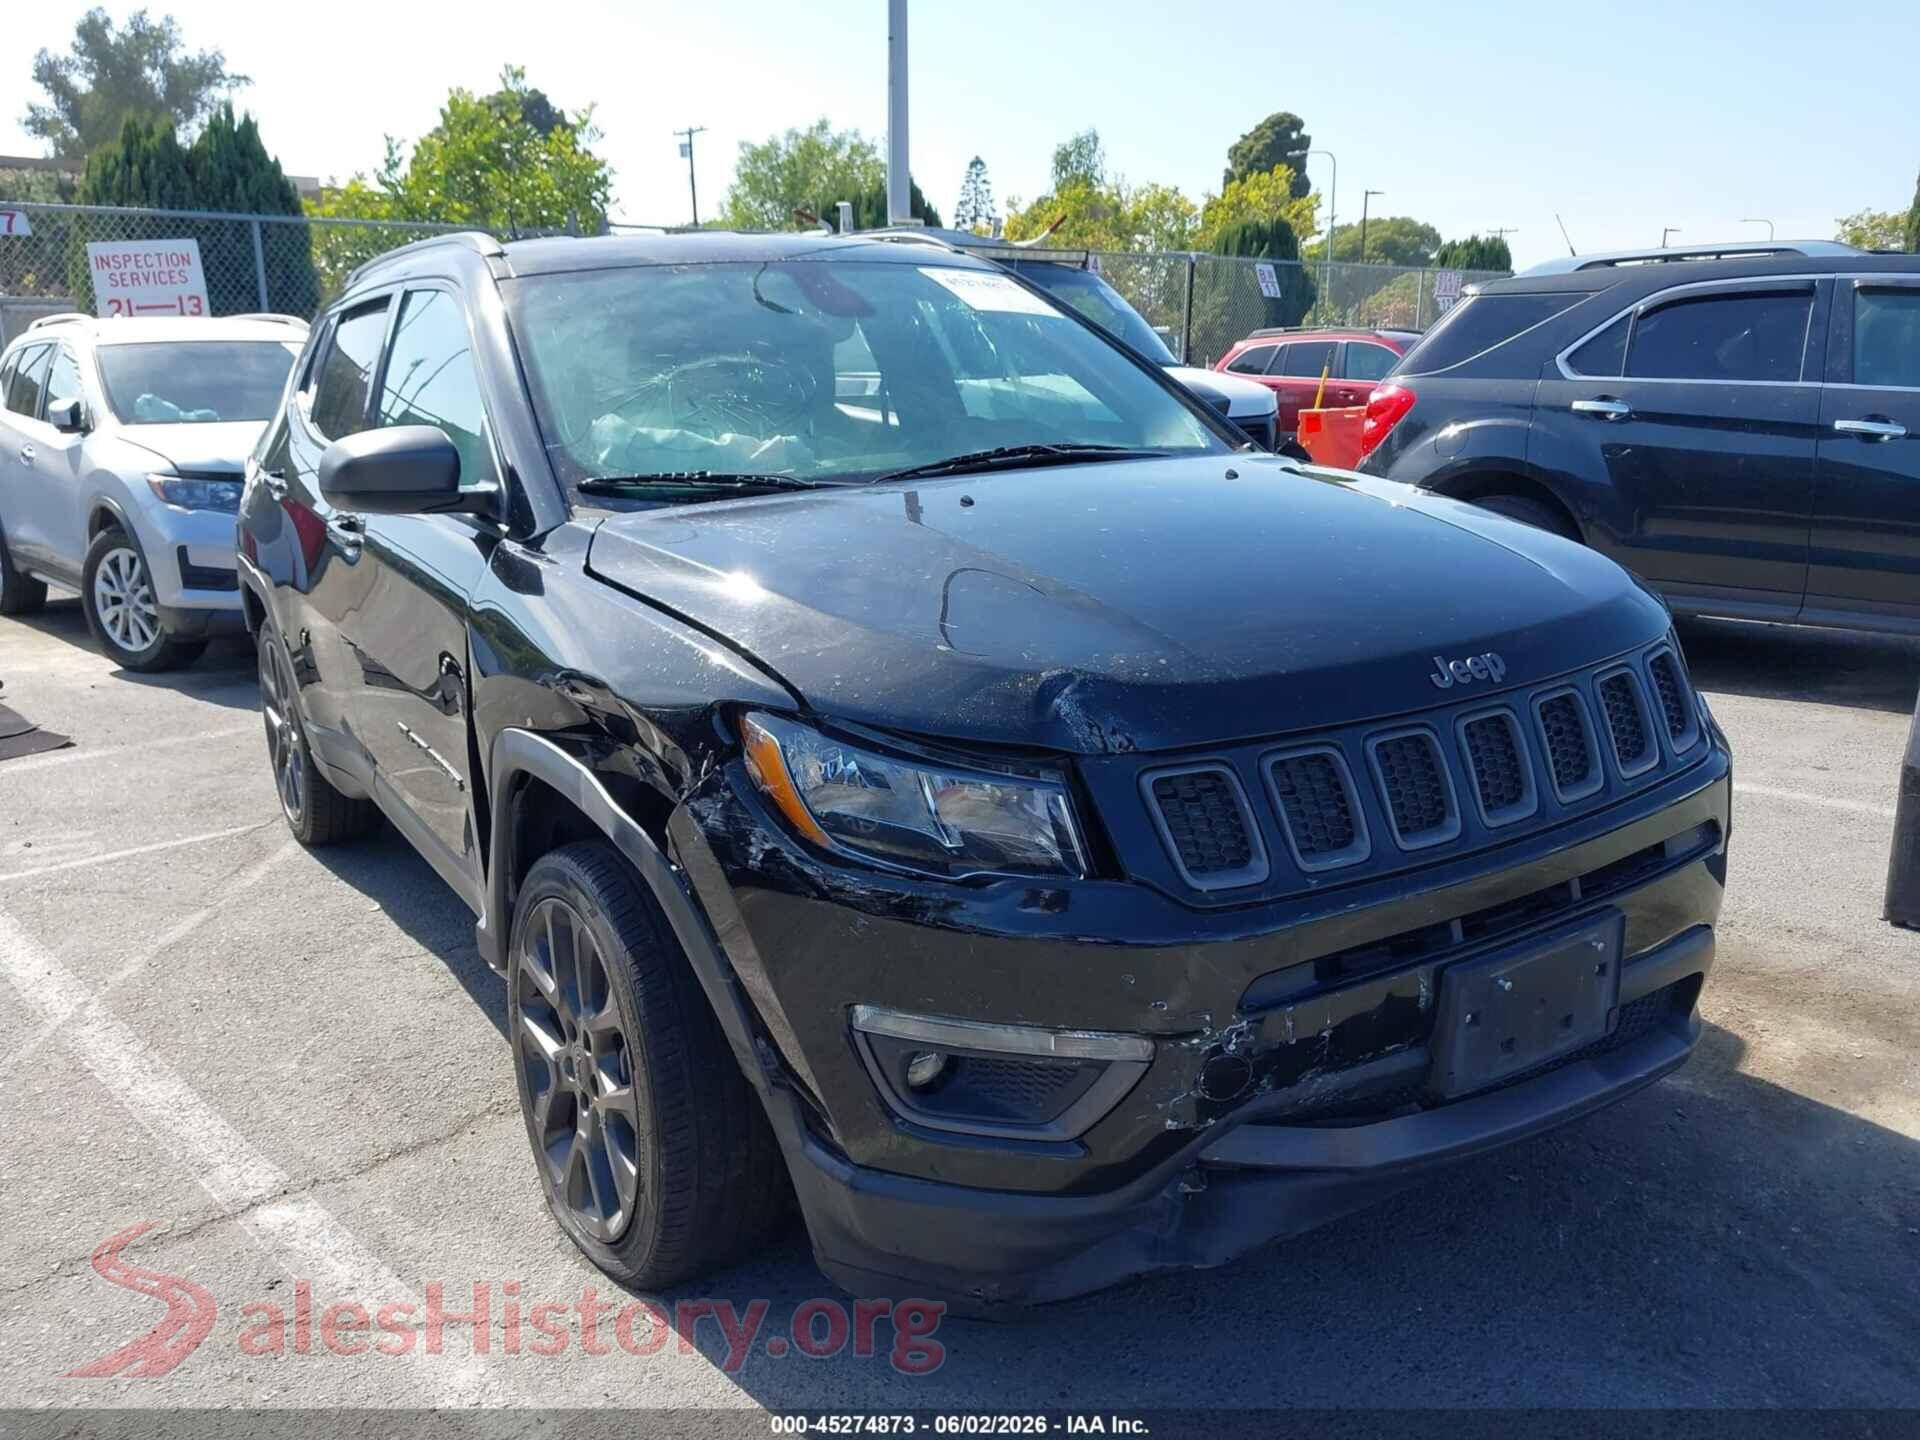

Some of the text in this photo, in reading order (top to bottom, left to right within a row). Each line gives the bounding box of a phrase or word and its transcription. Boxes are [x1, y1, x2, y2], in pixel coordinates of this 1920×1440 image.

[0, 212, 16, 233] 7
[95, 252, 192, 271] INSPECTION
[108, 270, 189, 288] SERVICES
[1430, 652, 1506, 688] Jeep
